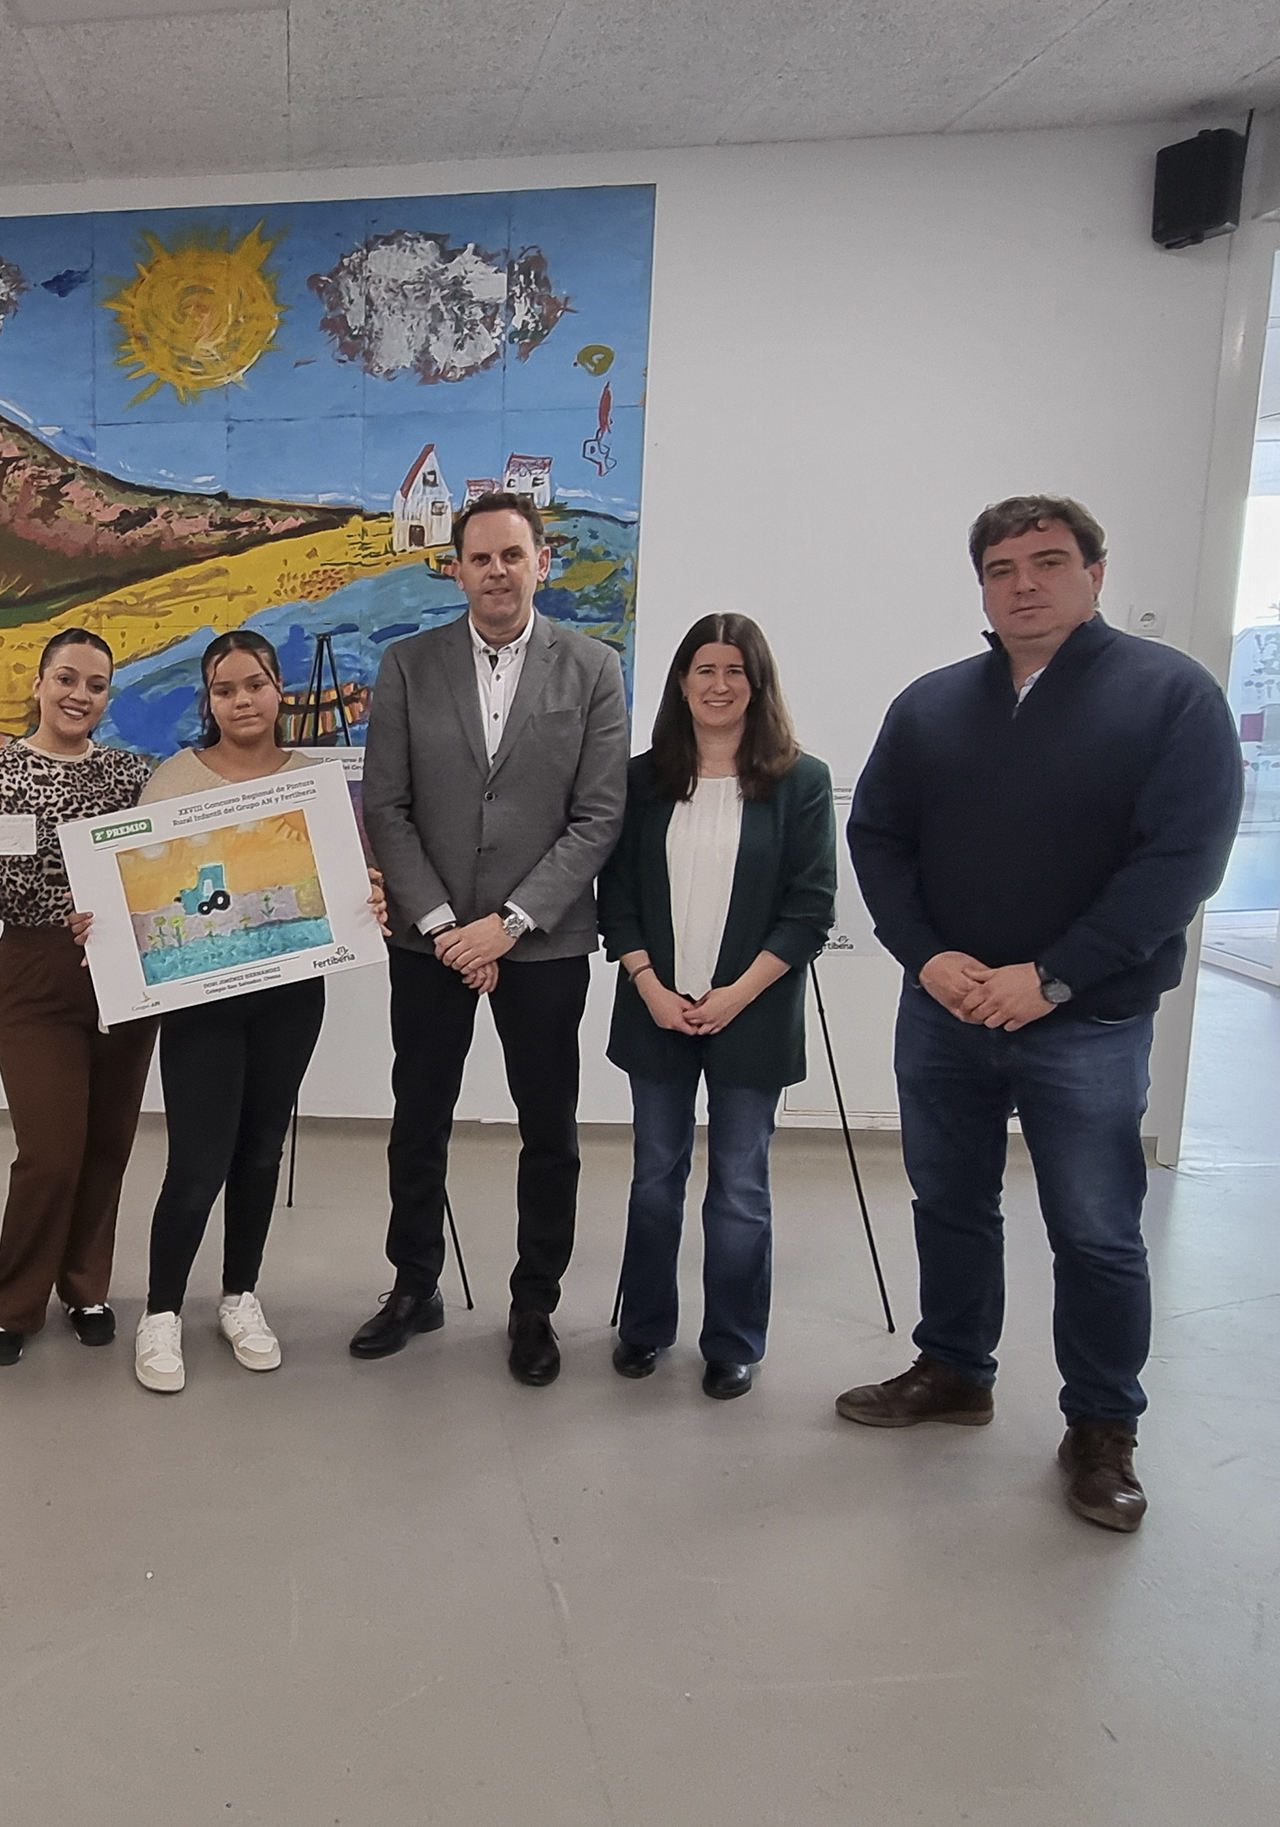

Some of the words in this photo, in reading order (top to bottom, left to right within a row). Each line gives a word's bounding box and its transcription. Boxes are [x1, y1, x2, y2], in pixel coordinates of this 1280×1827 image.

[204, 797, 240, 810] Concurso
[242, 788, 274, 801] Regional
[276, 785, 285, 793] de
[286, 779, 315, 790] Pintura
[173, 816, 193, 826] Rural
[194, 810, 222, 822] Infantil
[223, 806, 235, 815] del
[236, 801, 260, 813] Grupo
[261, 797, 273, 806] AN
[280, 788, 316, 801] Fertiberia
[106, 821, 147, 838] PREMIO
[313, 953, 355, 969] Fertiberia
